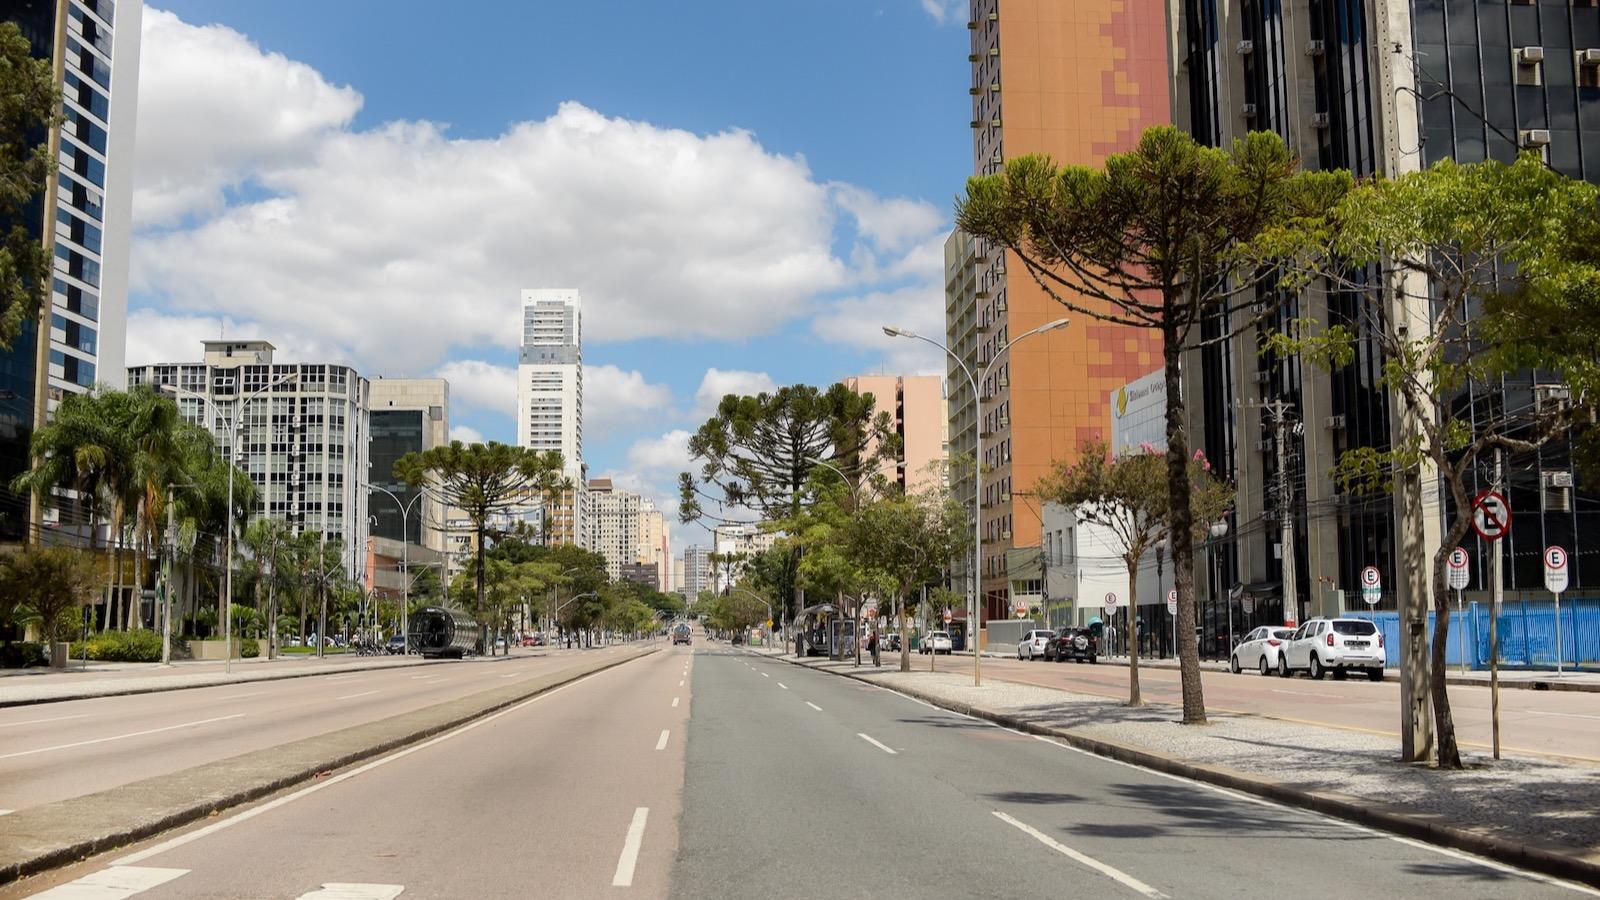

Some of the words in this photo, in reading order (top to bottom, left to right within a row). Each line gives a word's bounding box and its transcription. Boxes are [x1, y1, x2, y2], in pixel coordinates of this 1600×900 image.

[1483, 502, 1499, 529] E
[1453, 552, 1461, 563] E
[1551, 552, 1560, 564] E
[1367, 571, 1375, 581] E
